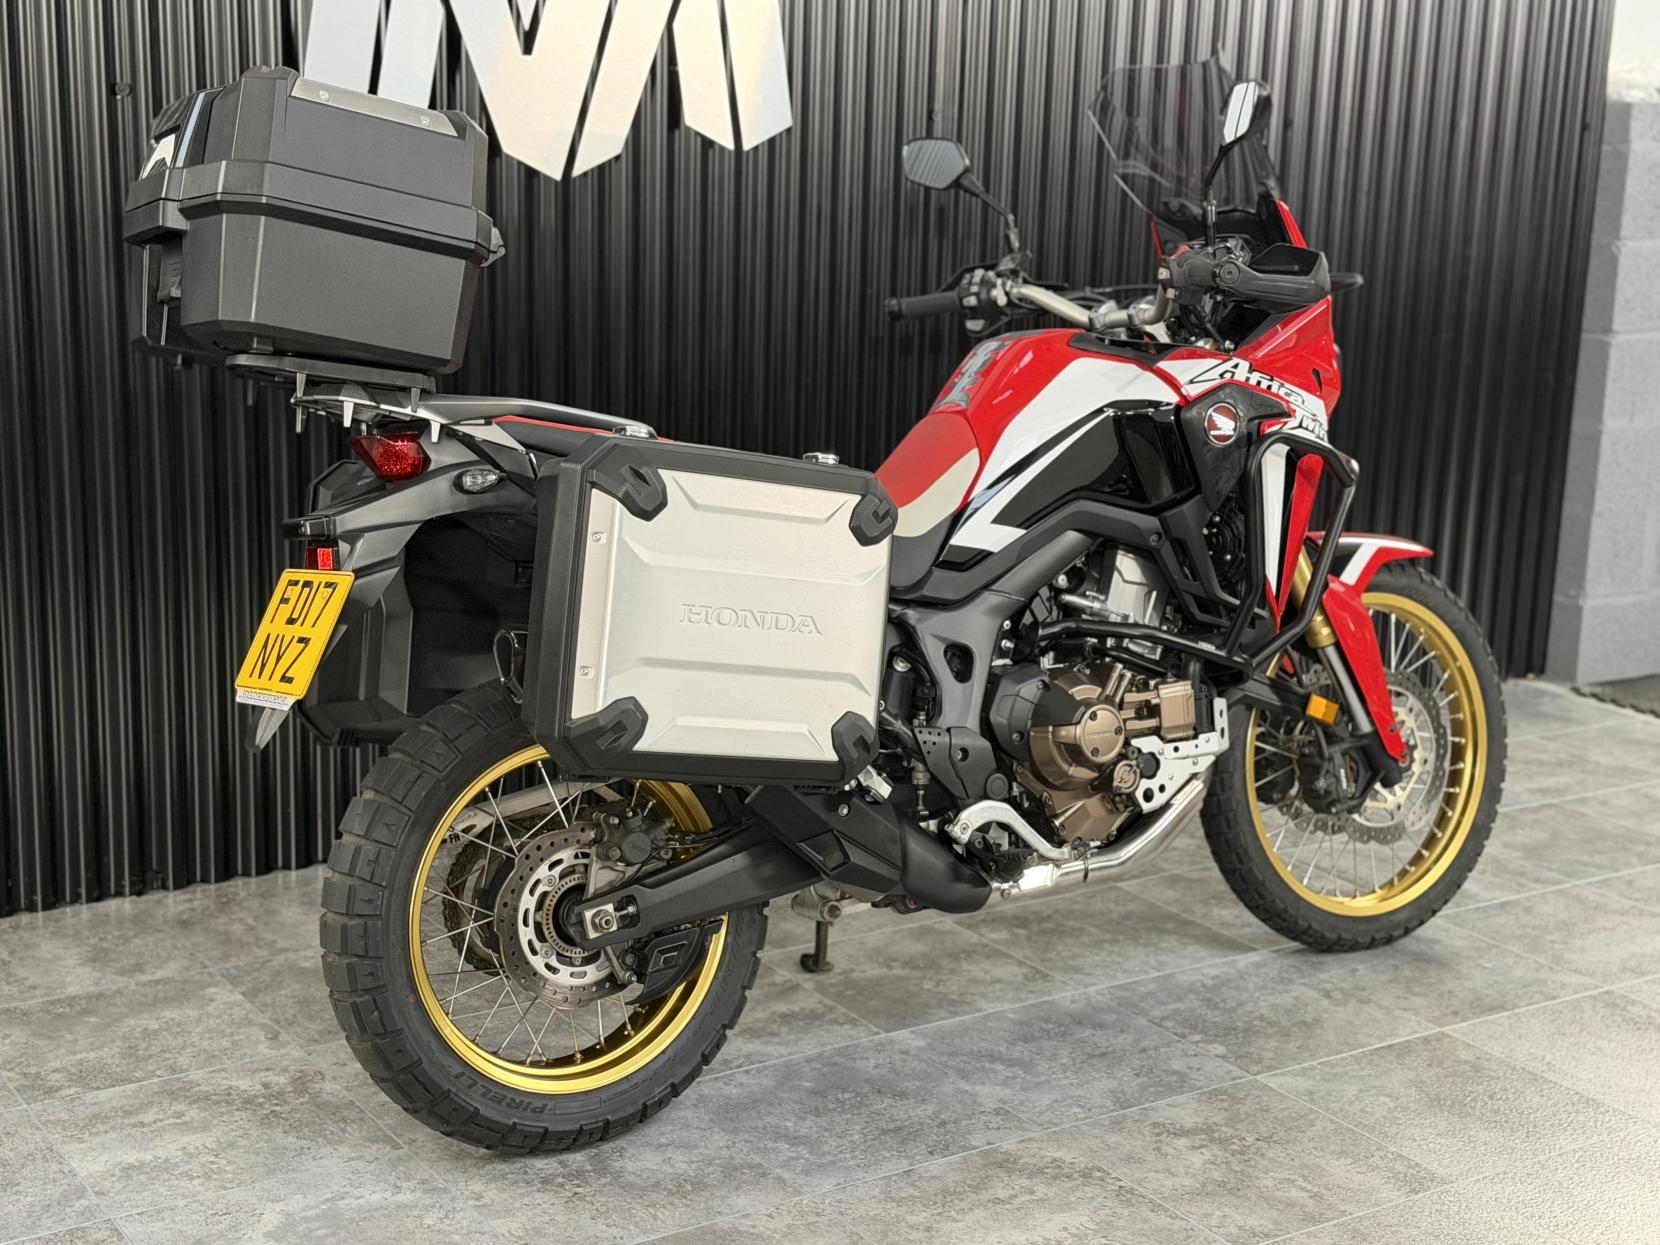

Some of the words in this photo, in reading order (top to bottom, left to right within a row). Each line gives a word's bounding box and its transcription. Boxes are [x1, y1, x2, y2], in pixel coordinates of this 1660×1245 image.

[269, 579, 338, 629] FD17
[680, 603, 823, 636] HONDA
[249, 632, 312, 684] NYZ
[454, 1070, 550, 1115] PIRELLI
